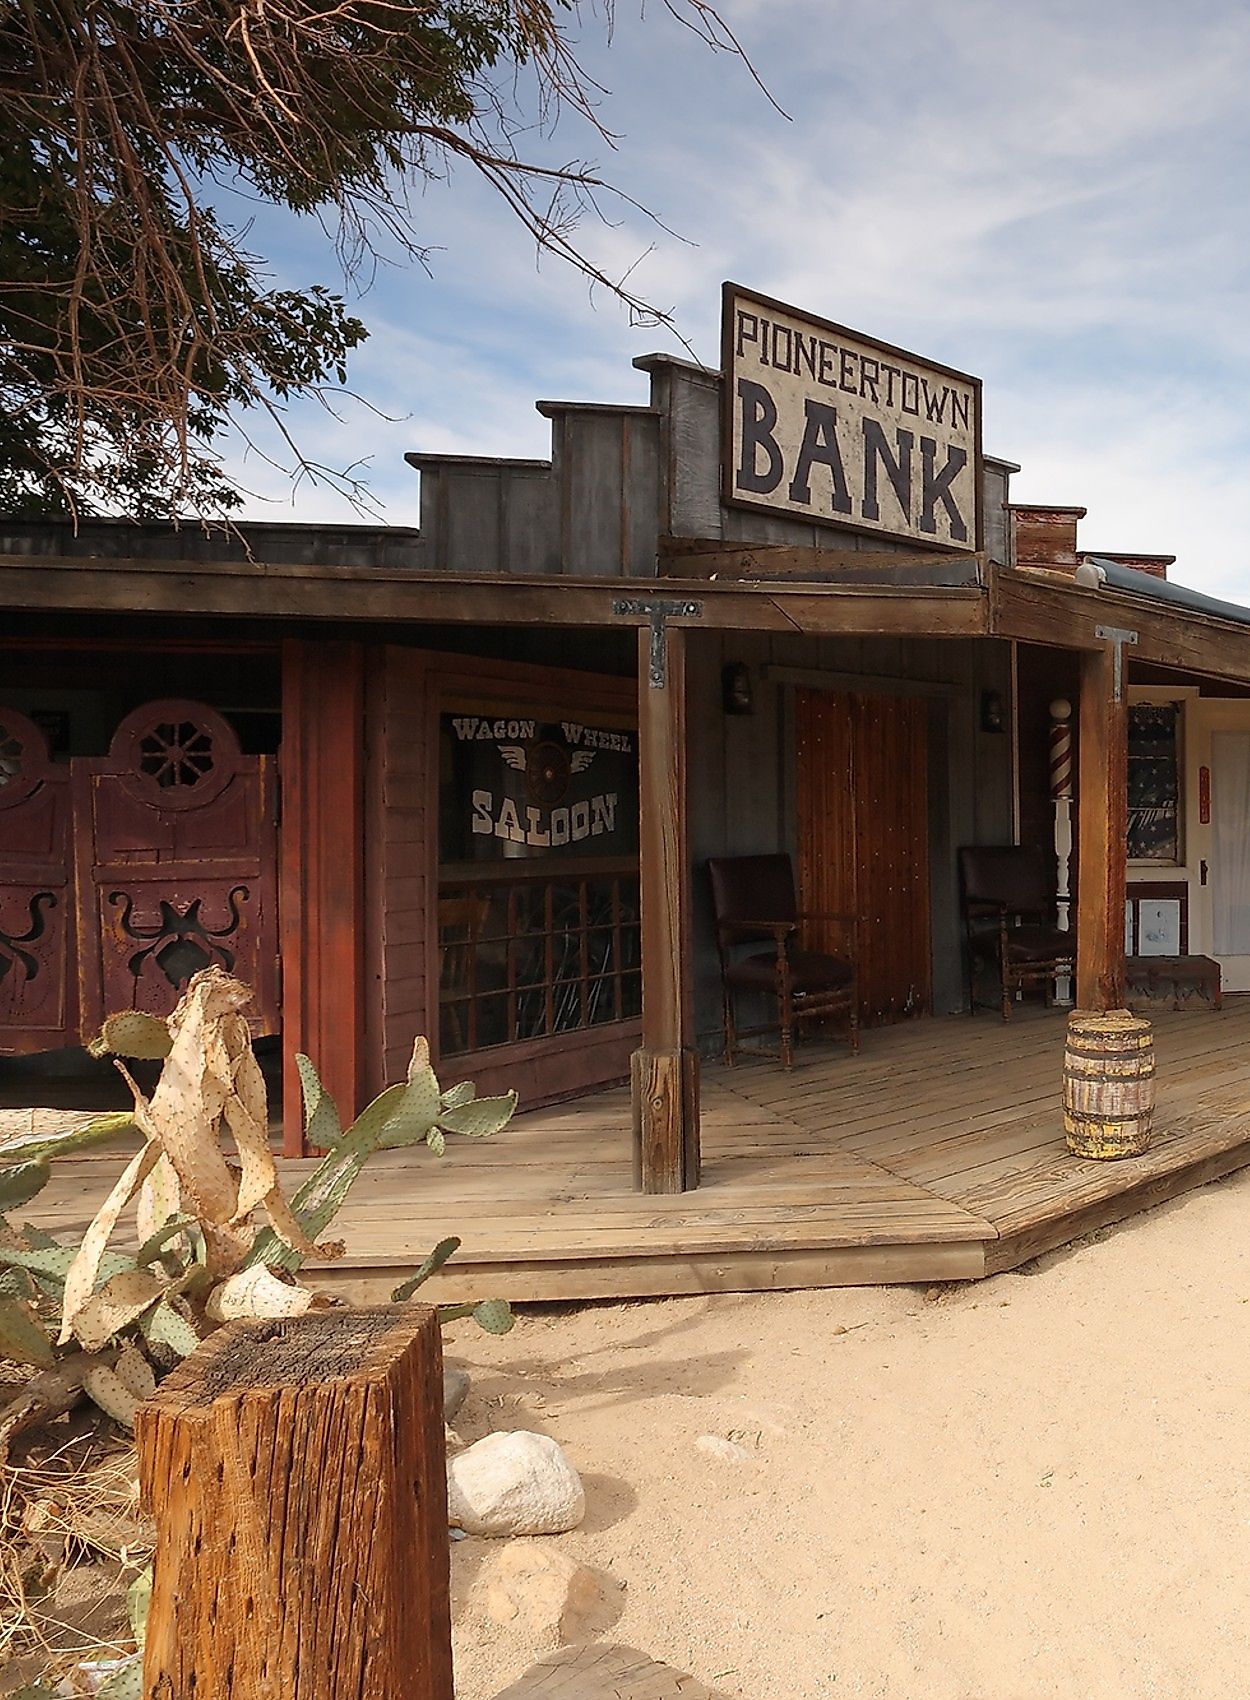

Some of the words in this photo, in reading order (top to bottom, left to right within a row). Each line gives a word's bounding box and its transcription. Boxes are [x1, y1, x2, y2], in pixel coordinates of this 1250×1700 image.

[736, 309, 969, 431] PIONEERTOWN
[736, 377, 967, 542] BANK
[452, 718, 536, 741] WAGON
[561, 721, 632, 753] WHEEL
[472, 789, 618, 847] SALOON
